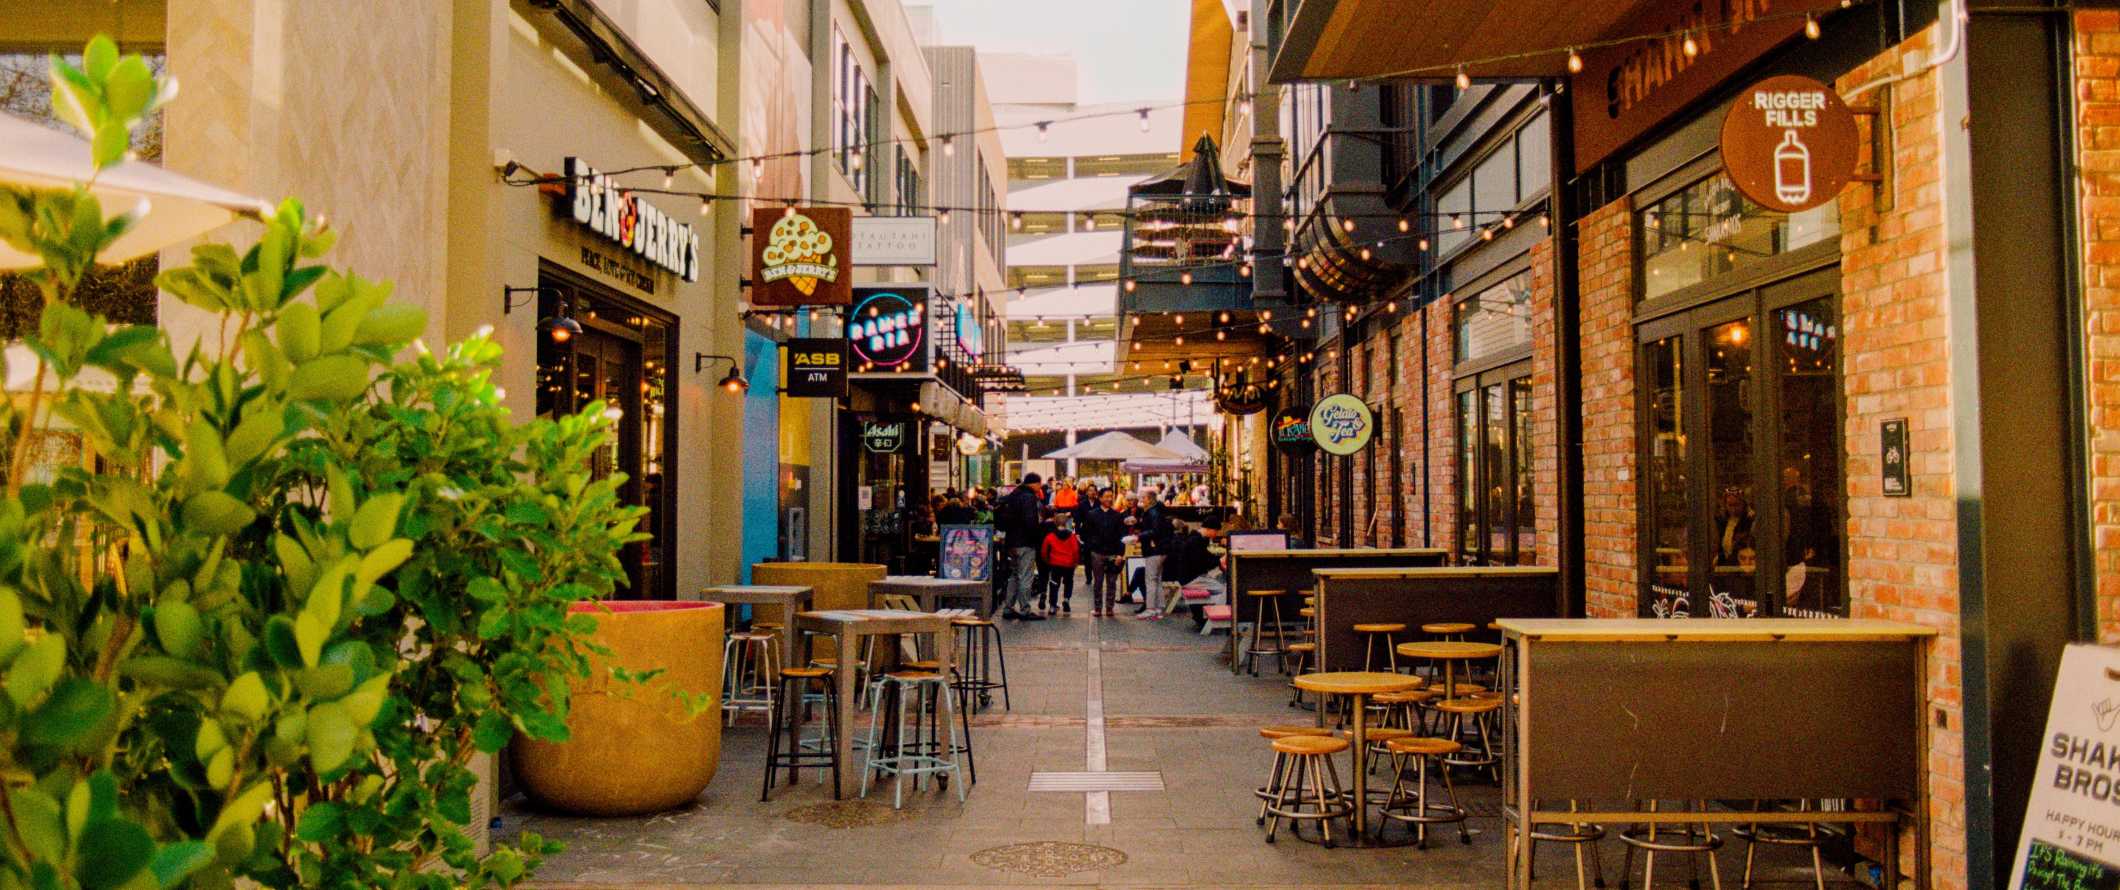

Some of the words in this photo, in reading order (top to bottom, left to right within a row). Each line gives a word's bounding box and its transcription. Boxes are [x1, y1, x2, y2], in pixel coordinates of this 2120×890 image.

[1754, 90, 1825, 111] RIGGER
[1765, 109, 1817, 128] FILLS
[573, 157, 620, 242] BEN
[794, 353, 840, 365] ASB
[808, 372, 828, 382] ATM
[866, 423, 899, 437] Asahi
[2053, 764, 2120, 806] BROS
[2046, 809, 2086, 829] HAPPY
